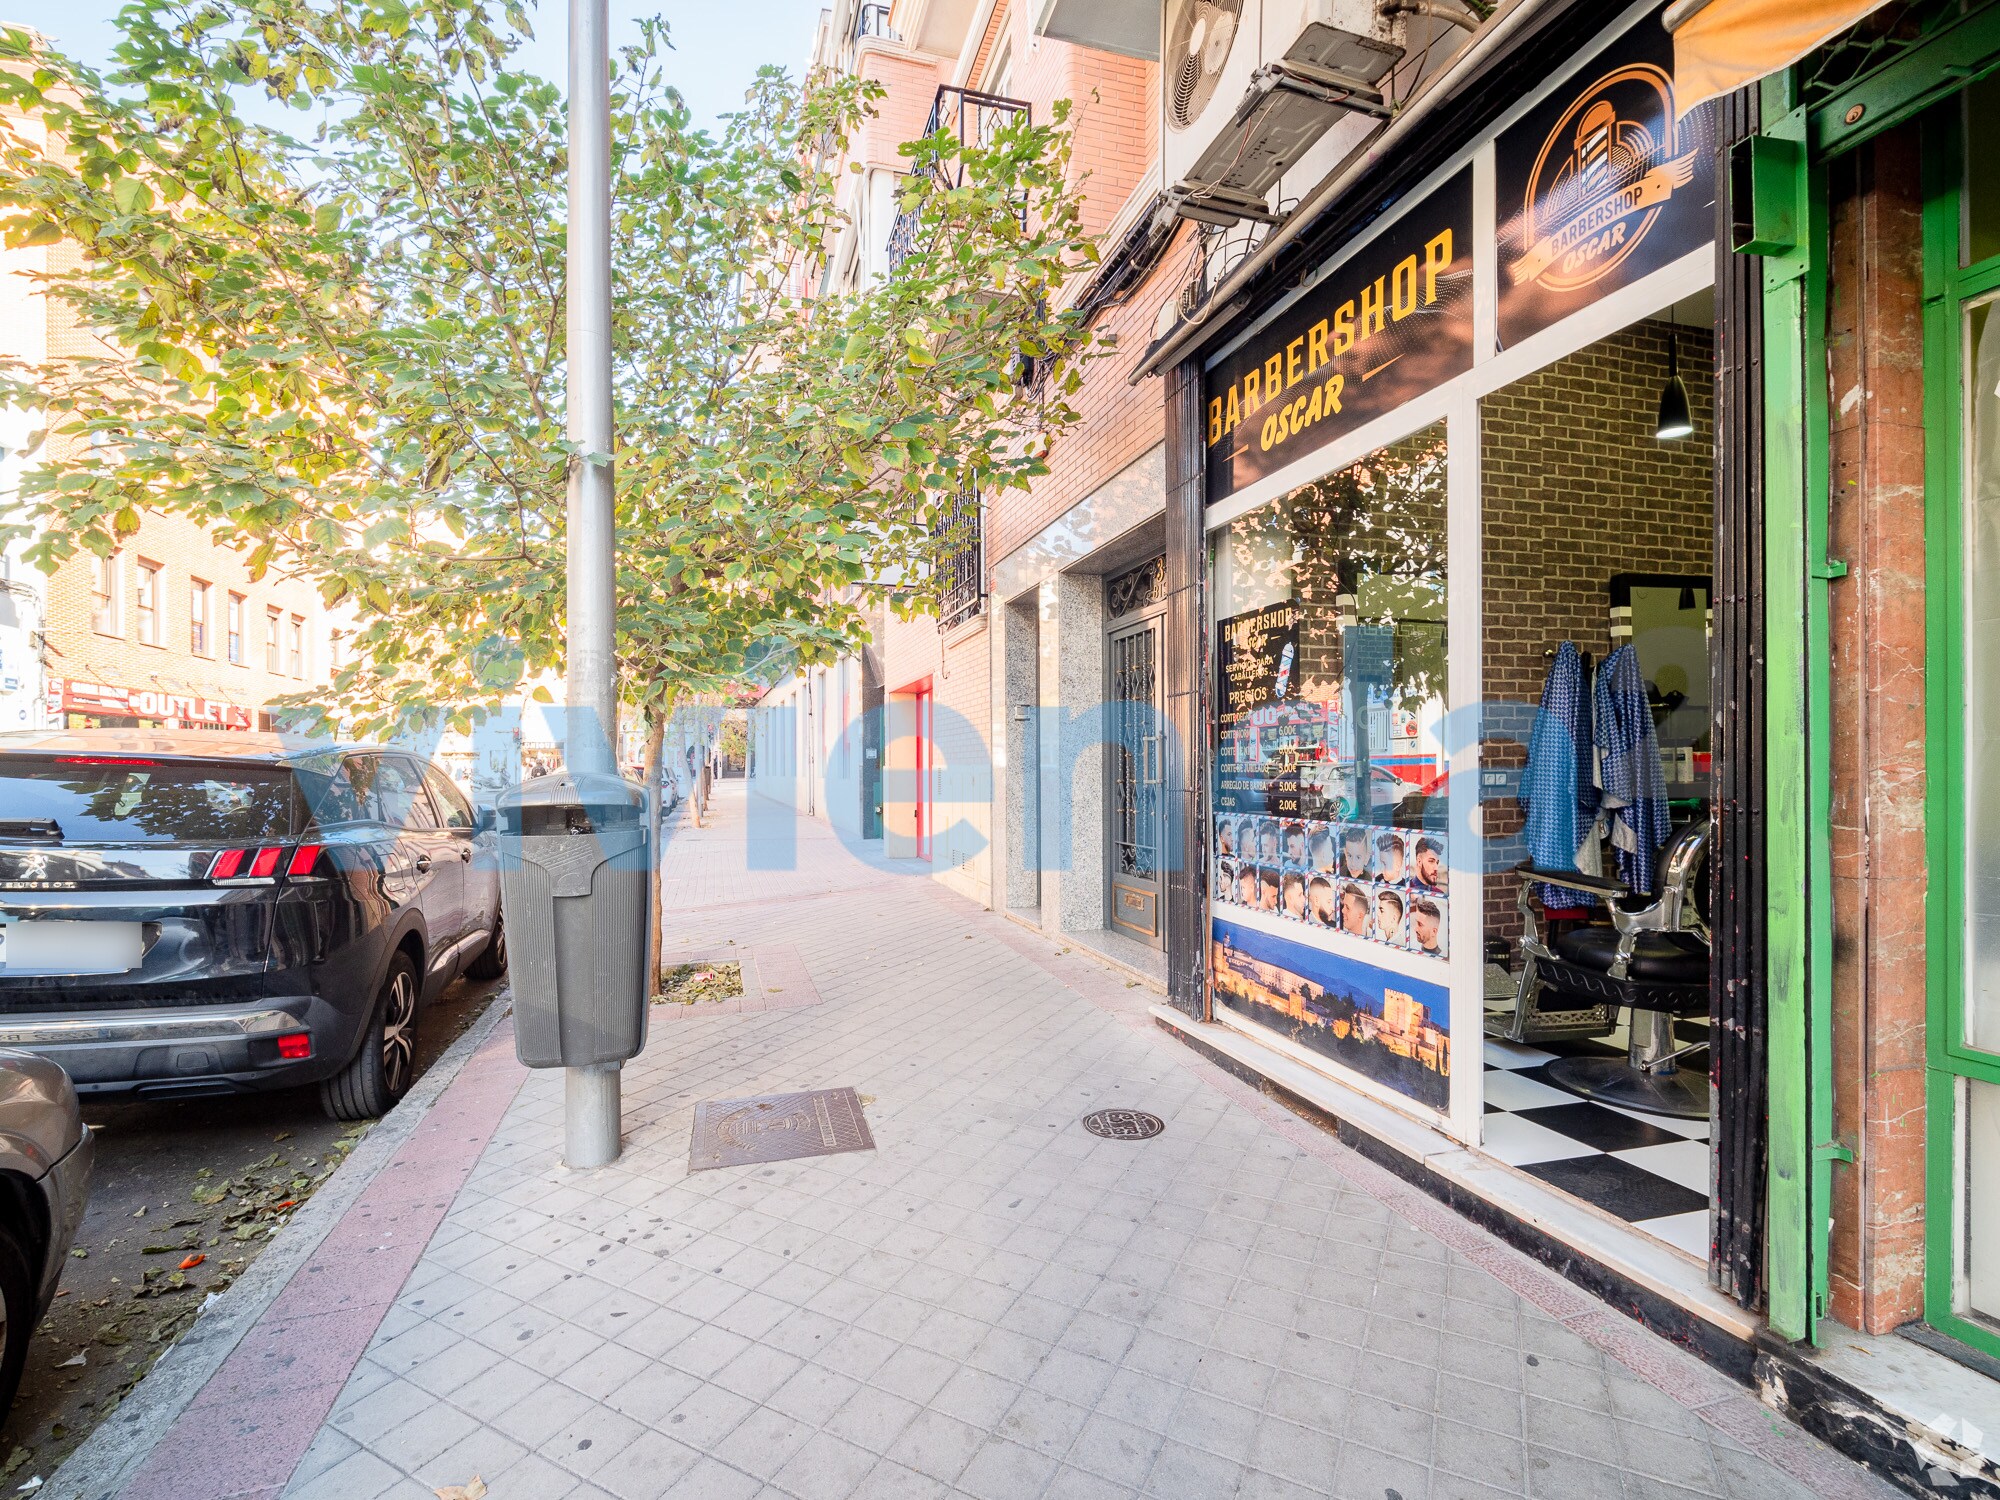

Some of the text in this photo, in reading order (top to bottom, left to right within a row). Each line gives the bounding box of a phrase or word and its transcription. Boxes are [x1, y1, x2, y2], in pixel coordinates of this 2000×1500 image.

[1551, 186, 1643, 256] BARBERSHOP
[1562, 221, 1627, 273] OSCAR
[1208, 228, 1453, 449] BARBERSHOP
[1260, 374, 1345, 451] OSCAR
[139, 691, 231, 722] OUTLET
[1229, 687, 1268, 704] PRECIOS
[1278, 725, 1298, 736] 6,00€
[1220, 780, 1243, 790] ARREGLO
[1242, 780, 1250, 791] DE
[1279, 781, 1298, 792] 5,00€
[1279, 799, 1298, 811] 2,00€
[0, 882, 75, 890] EUGEOT
